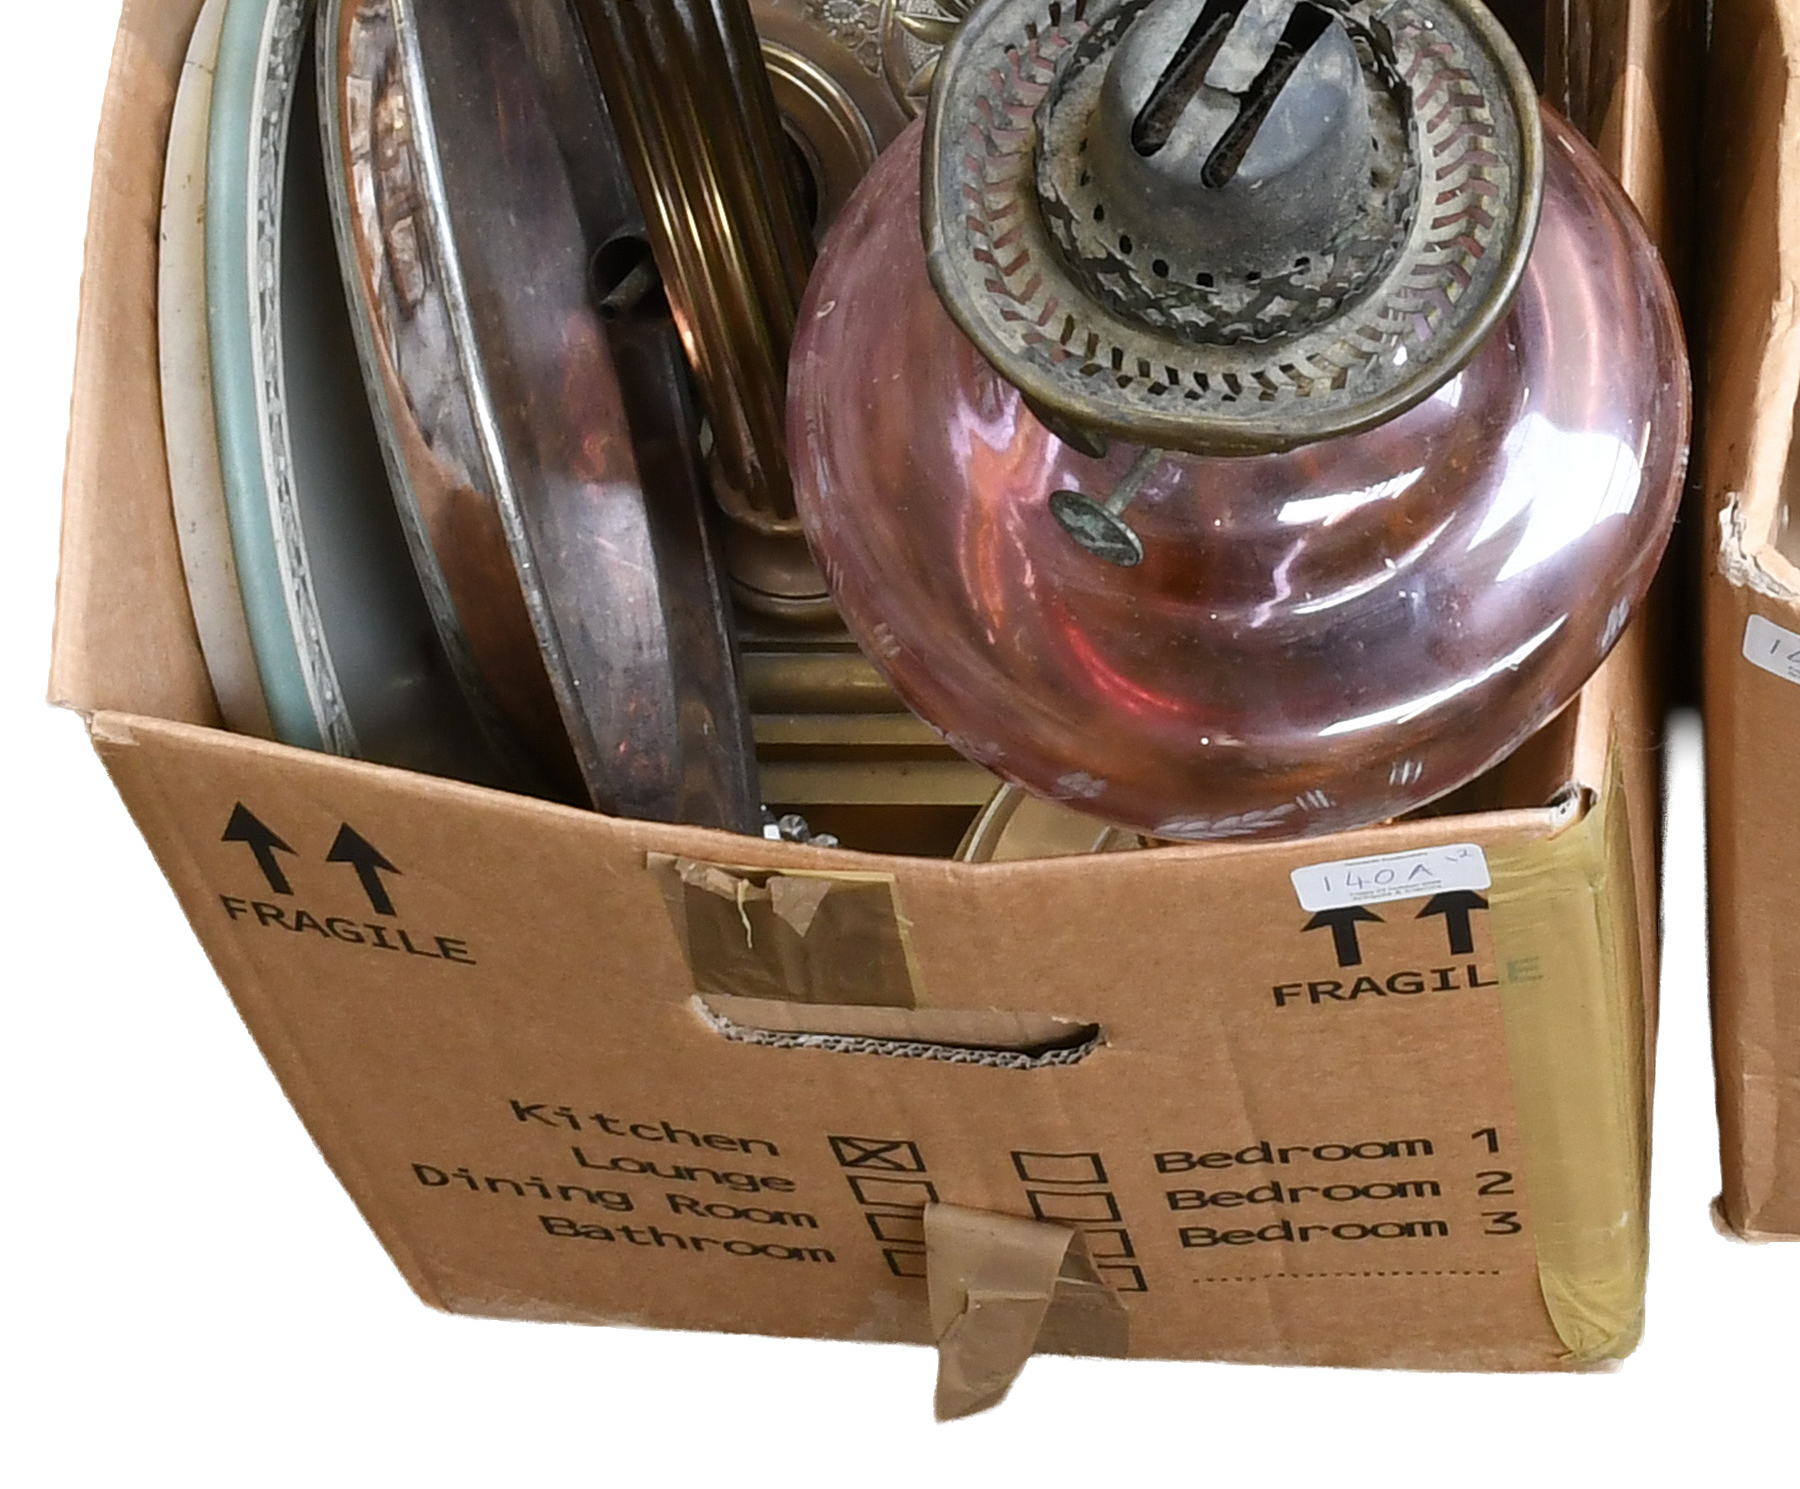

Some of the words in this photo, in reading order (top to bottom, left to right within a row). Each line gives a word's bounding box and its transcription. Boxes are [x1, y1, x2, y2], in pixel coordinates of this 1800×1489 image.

[218, 893, 477, 966] FRAGILE
[508, 1099, 780, 1157] Kitchen
[1152, 1138, 1435, 1174] Bedroom
[1471, 1127, 1500, 1154] 1
[571, 1145, 796, 1194] Lounge
[1165, 1180, 1442, 1211] Bedroom
[1475, 1170, 1515, 1197] 2
[411, 1163, 635, 1212] Dining
[665, 1192, 819, 1229] Room
[537, 1215, 837, 1263] Bathroom
[1178, 1218, 1449, 1249] Bedroom
[1481, 1210, 1523, 1236] 3
